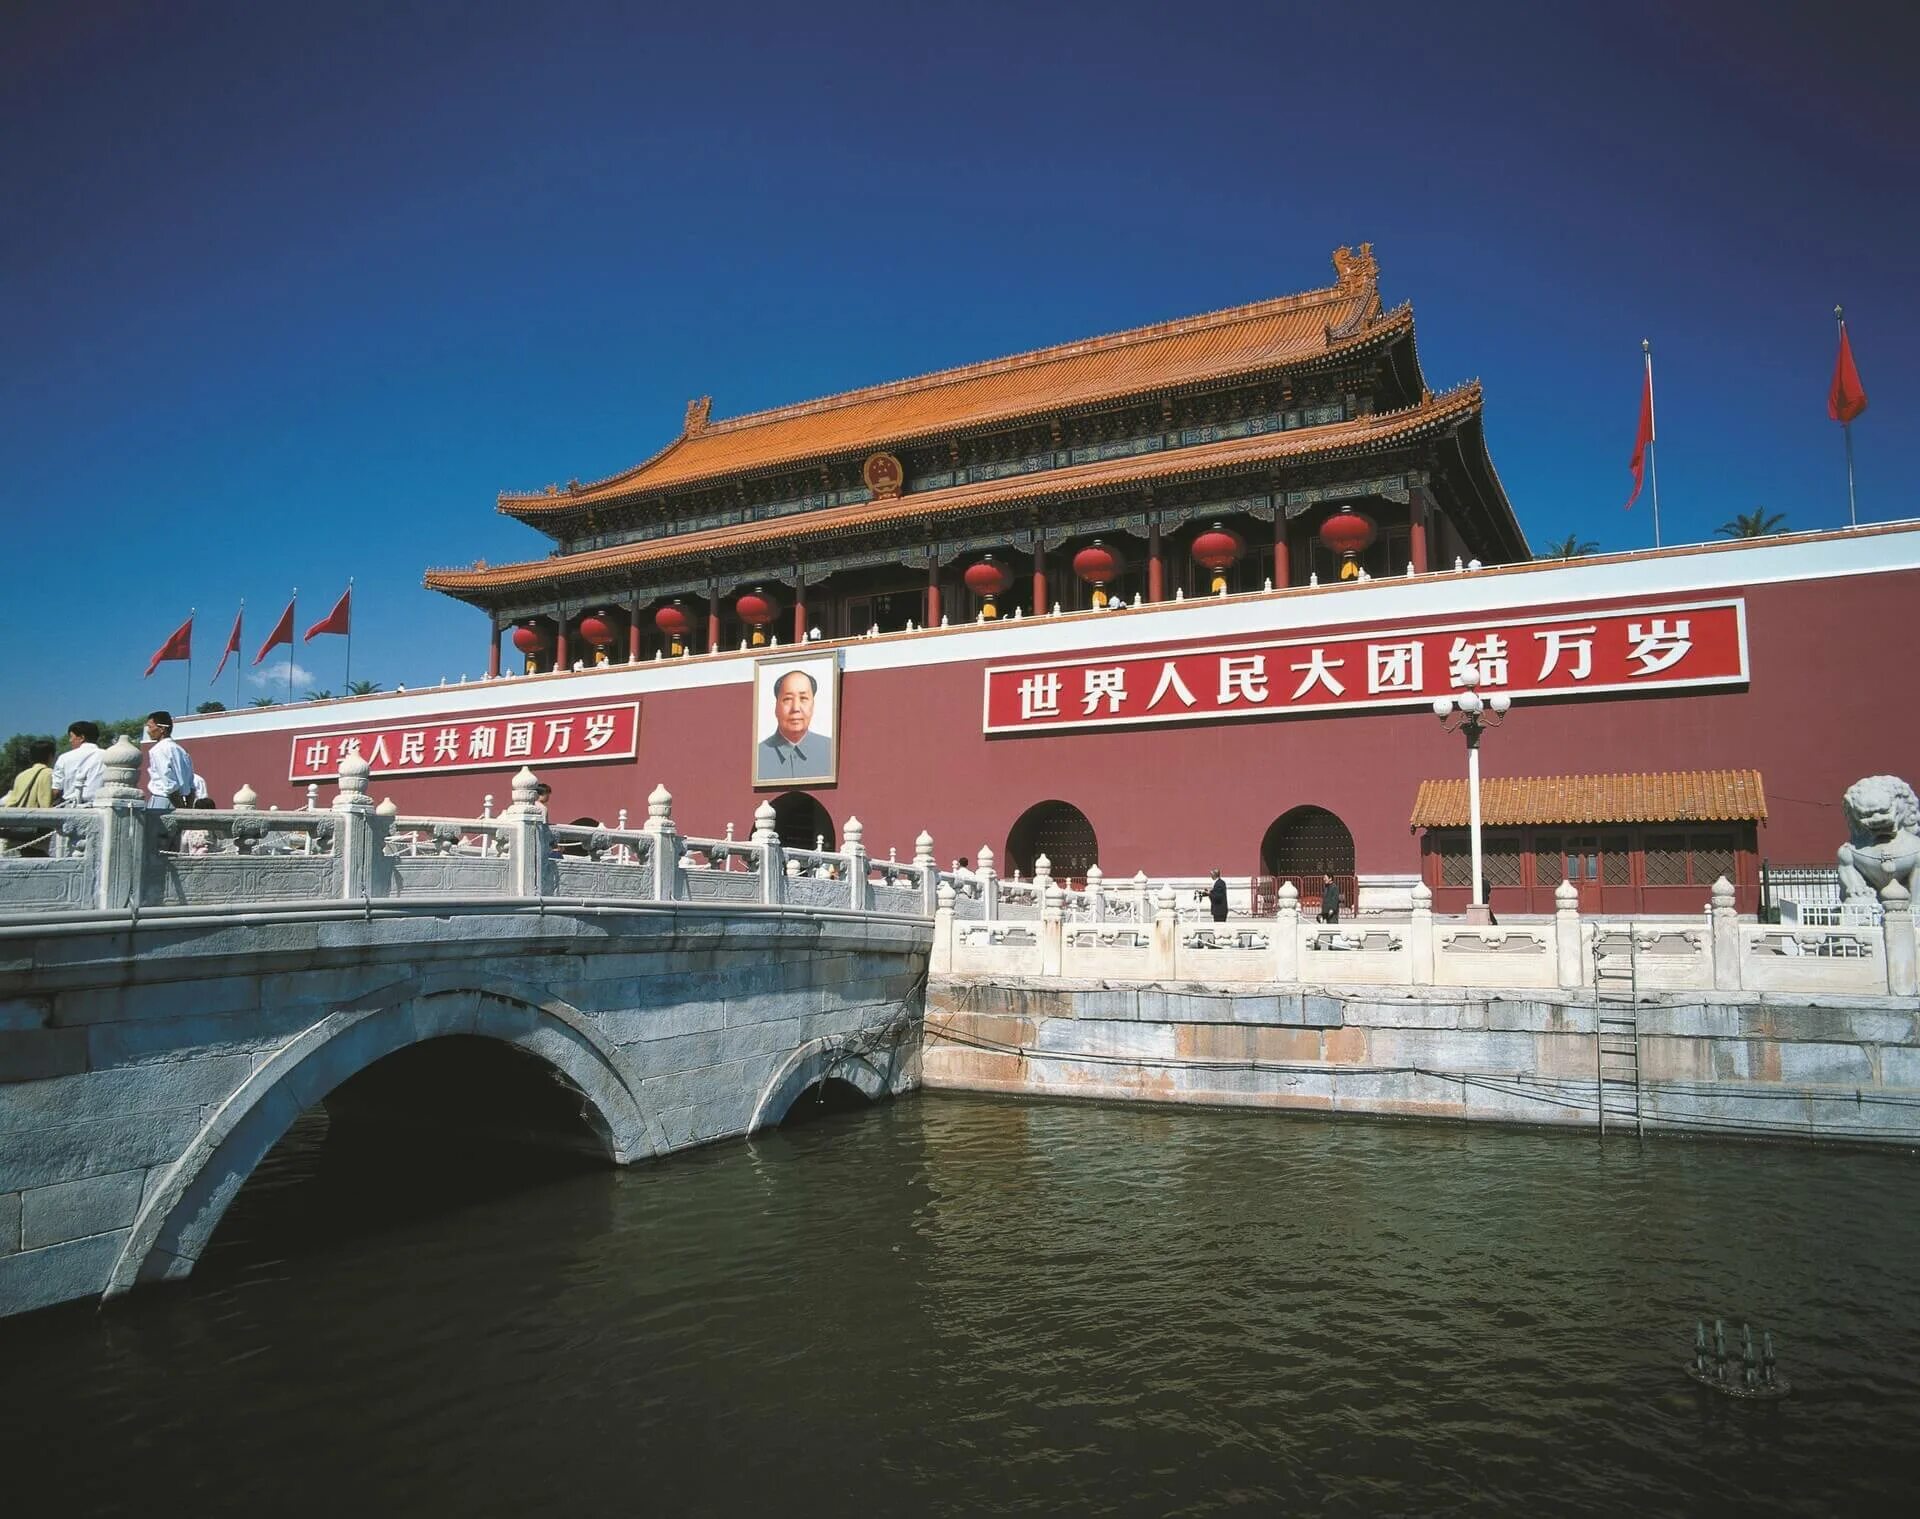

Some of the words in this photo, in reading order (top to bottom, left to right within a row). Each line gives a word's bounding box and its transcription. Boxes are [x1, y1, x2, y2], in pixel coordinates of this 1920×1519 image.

[1017, 619, 1693, 719] 世界人民大团结万岁
